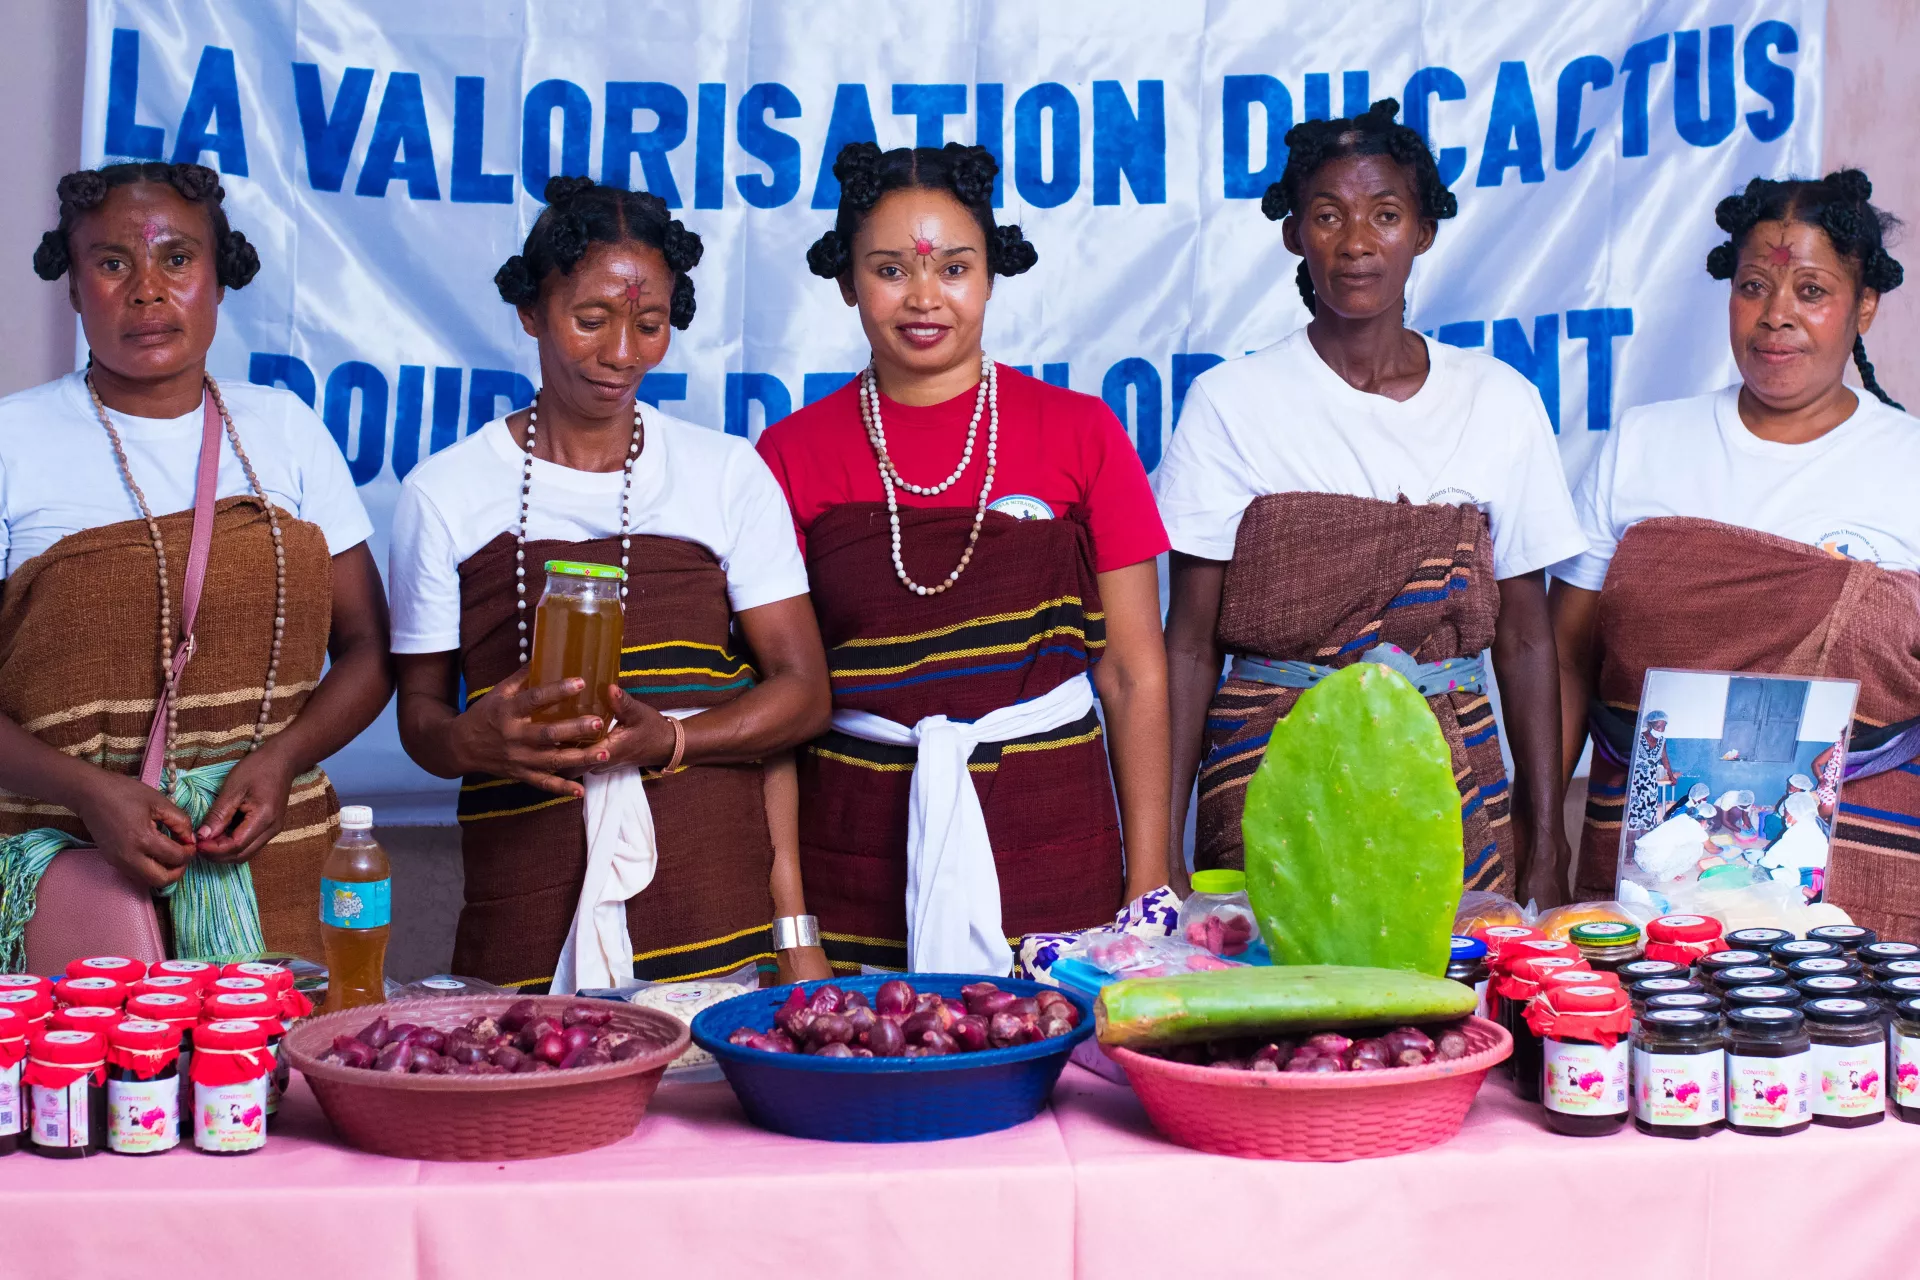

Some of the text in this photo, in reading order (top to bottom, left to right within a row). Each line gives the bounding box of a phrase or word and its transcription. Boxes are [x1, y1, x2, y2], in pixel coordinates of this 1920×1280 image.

[105, 28, 250, 178] LA
[292, 62, 1167, 210] VALORISATION
[1403, 19, 1799, 188] CACTUS
